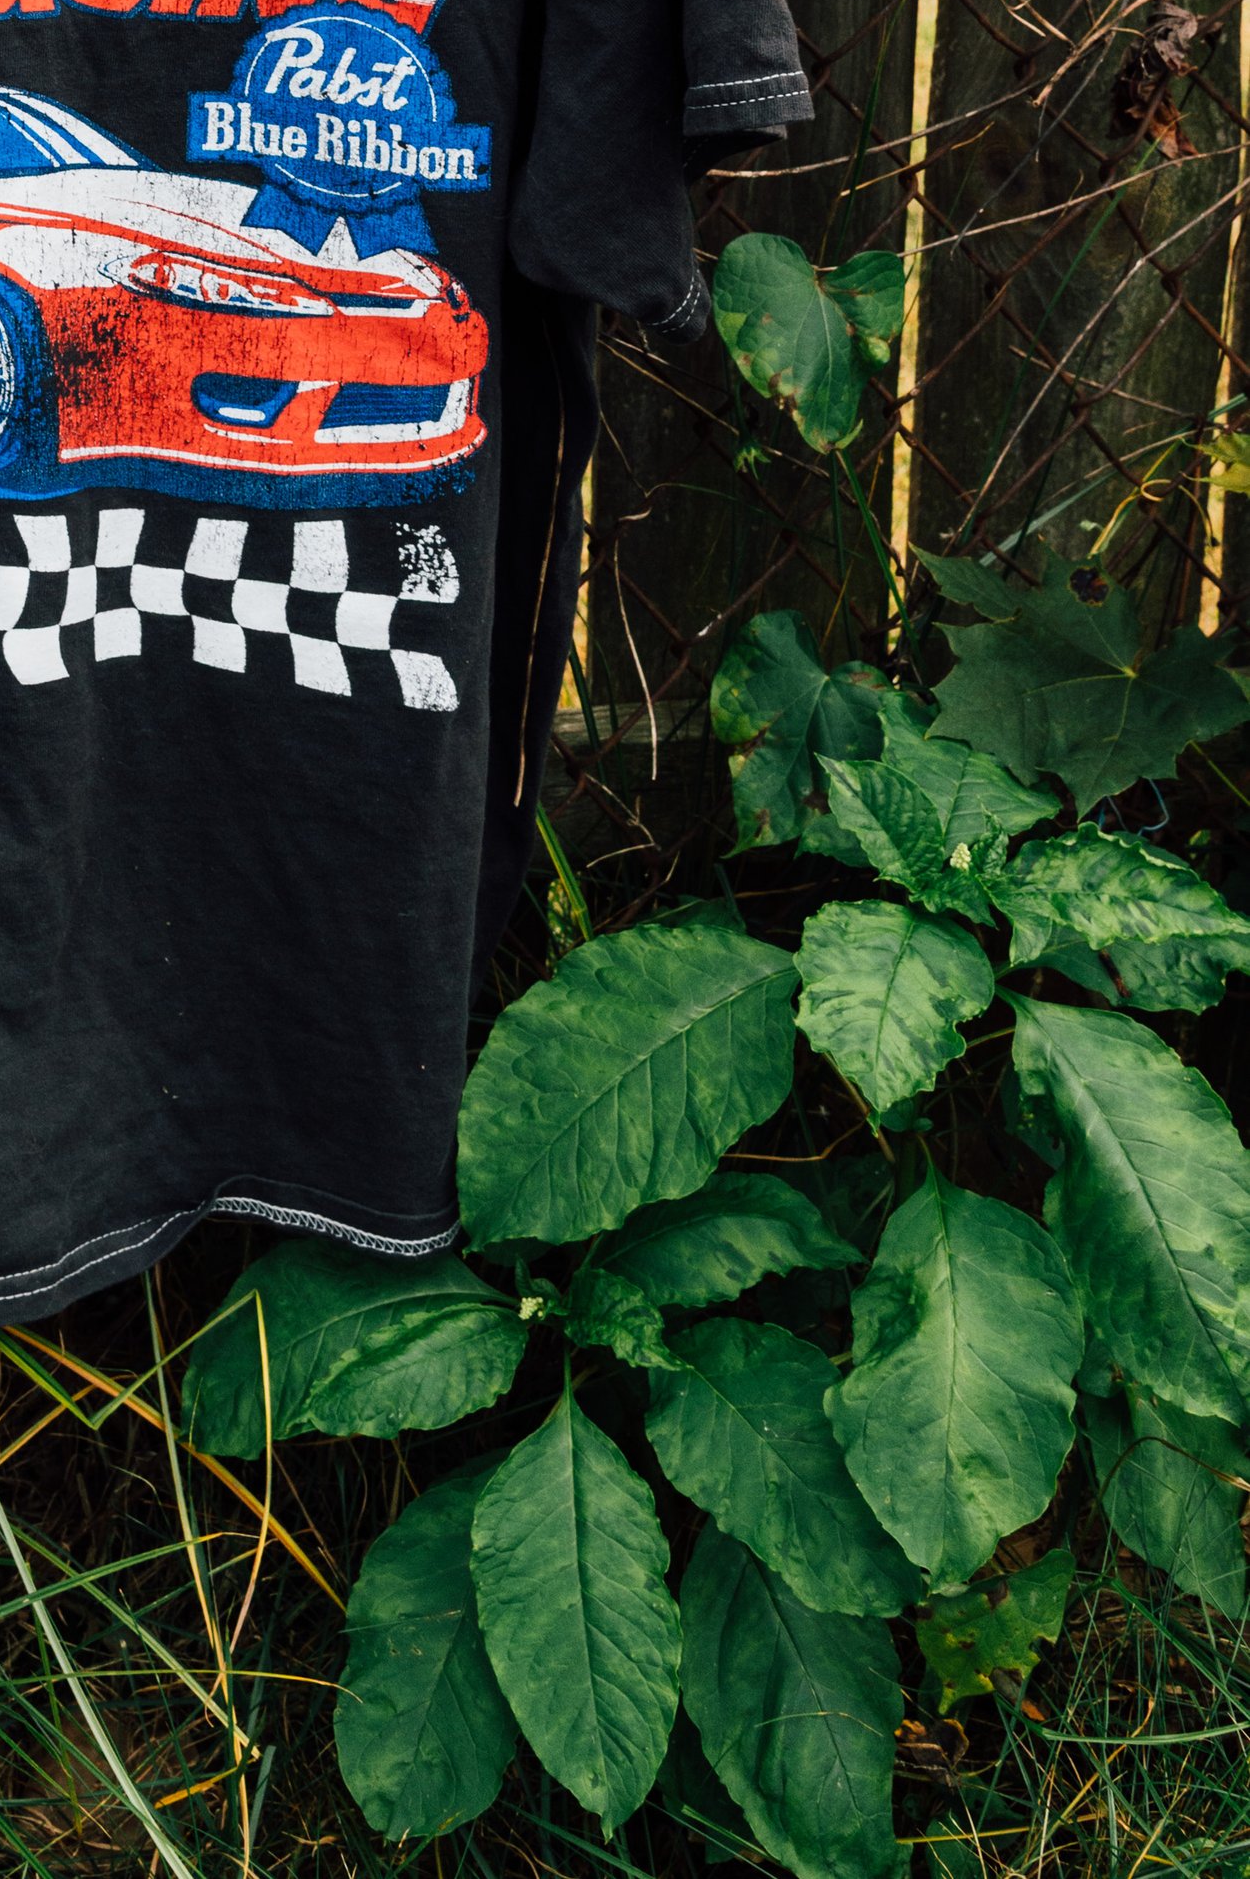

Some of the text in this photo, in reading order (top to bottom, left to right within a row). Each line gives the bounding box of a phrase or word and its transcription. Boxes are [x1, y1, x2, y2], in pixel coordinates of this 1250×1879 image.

[265, 27, 418, 111] Pabst
[202, 103, 478, 181] Blue Ribbon
